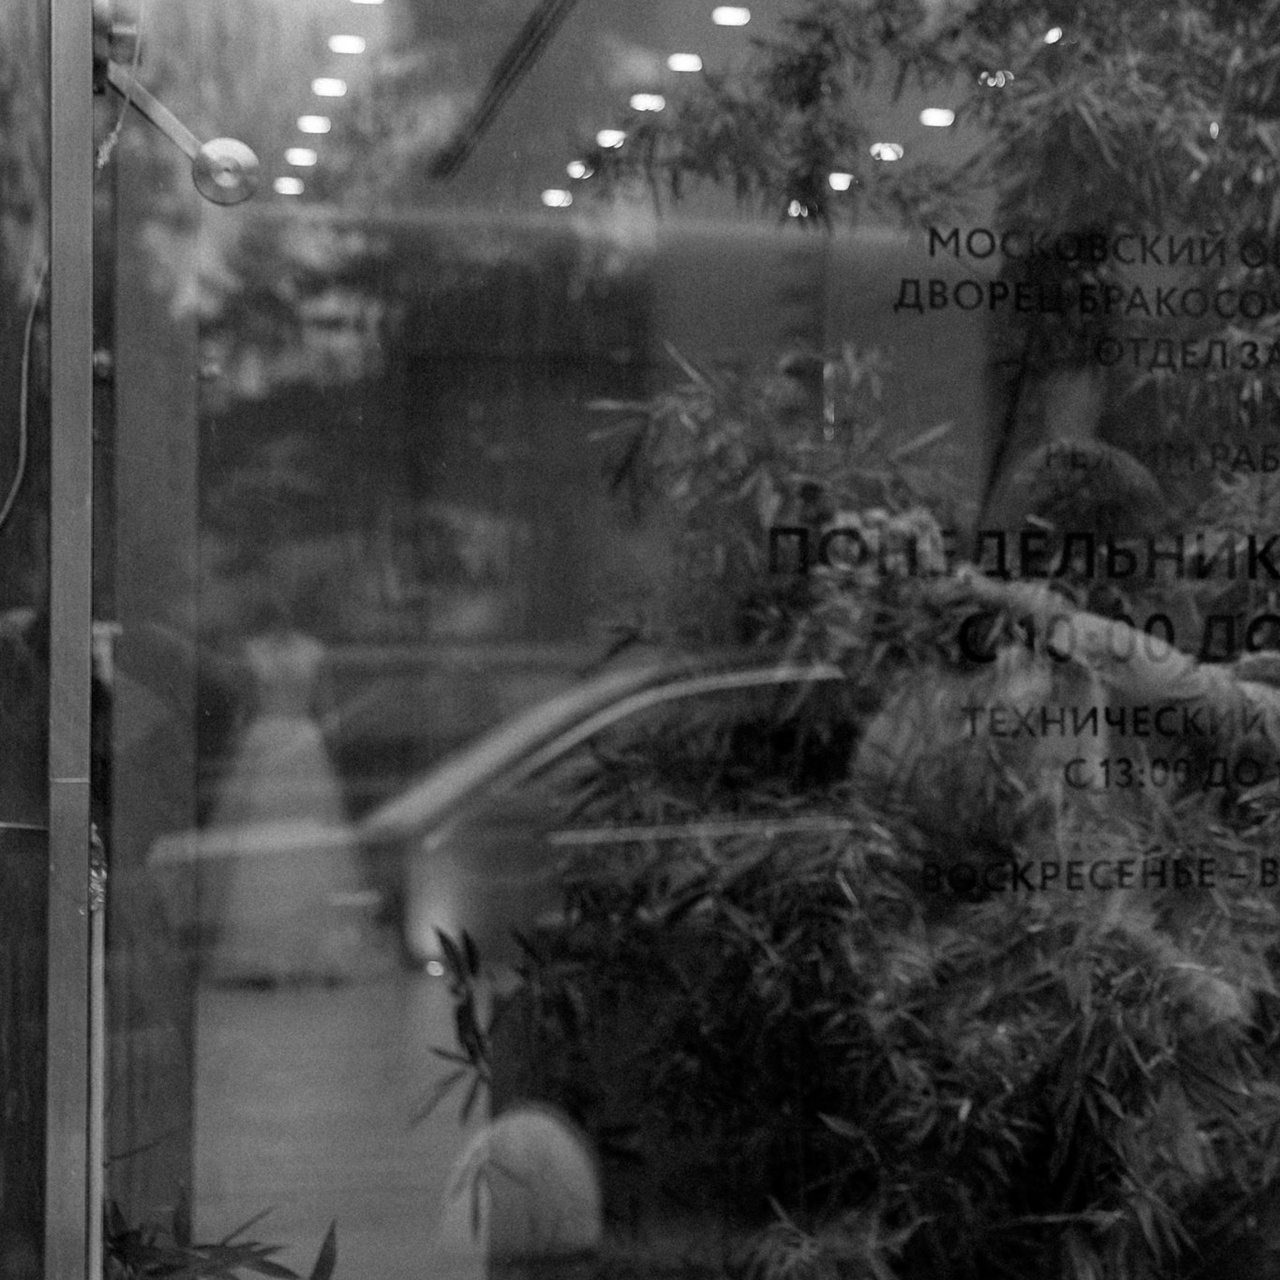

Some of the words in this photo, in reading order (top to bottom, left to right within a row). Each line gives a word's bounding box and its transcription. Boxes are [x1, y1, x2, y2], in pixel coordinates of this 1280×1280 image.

[928, 225, 1226, 269] МОСКОВСКИЙ
[893, 277, 1064, 316] ДВОРЕЦ
[1094, 337, 1228, 372] ОТДЕЛ
[1063, 757, 1091, 791] С
[1201, 757, 1264, 792] ДО
[921, 857, 1217, 894] ВОСКРЕСЕНЬЕ
